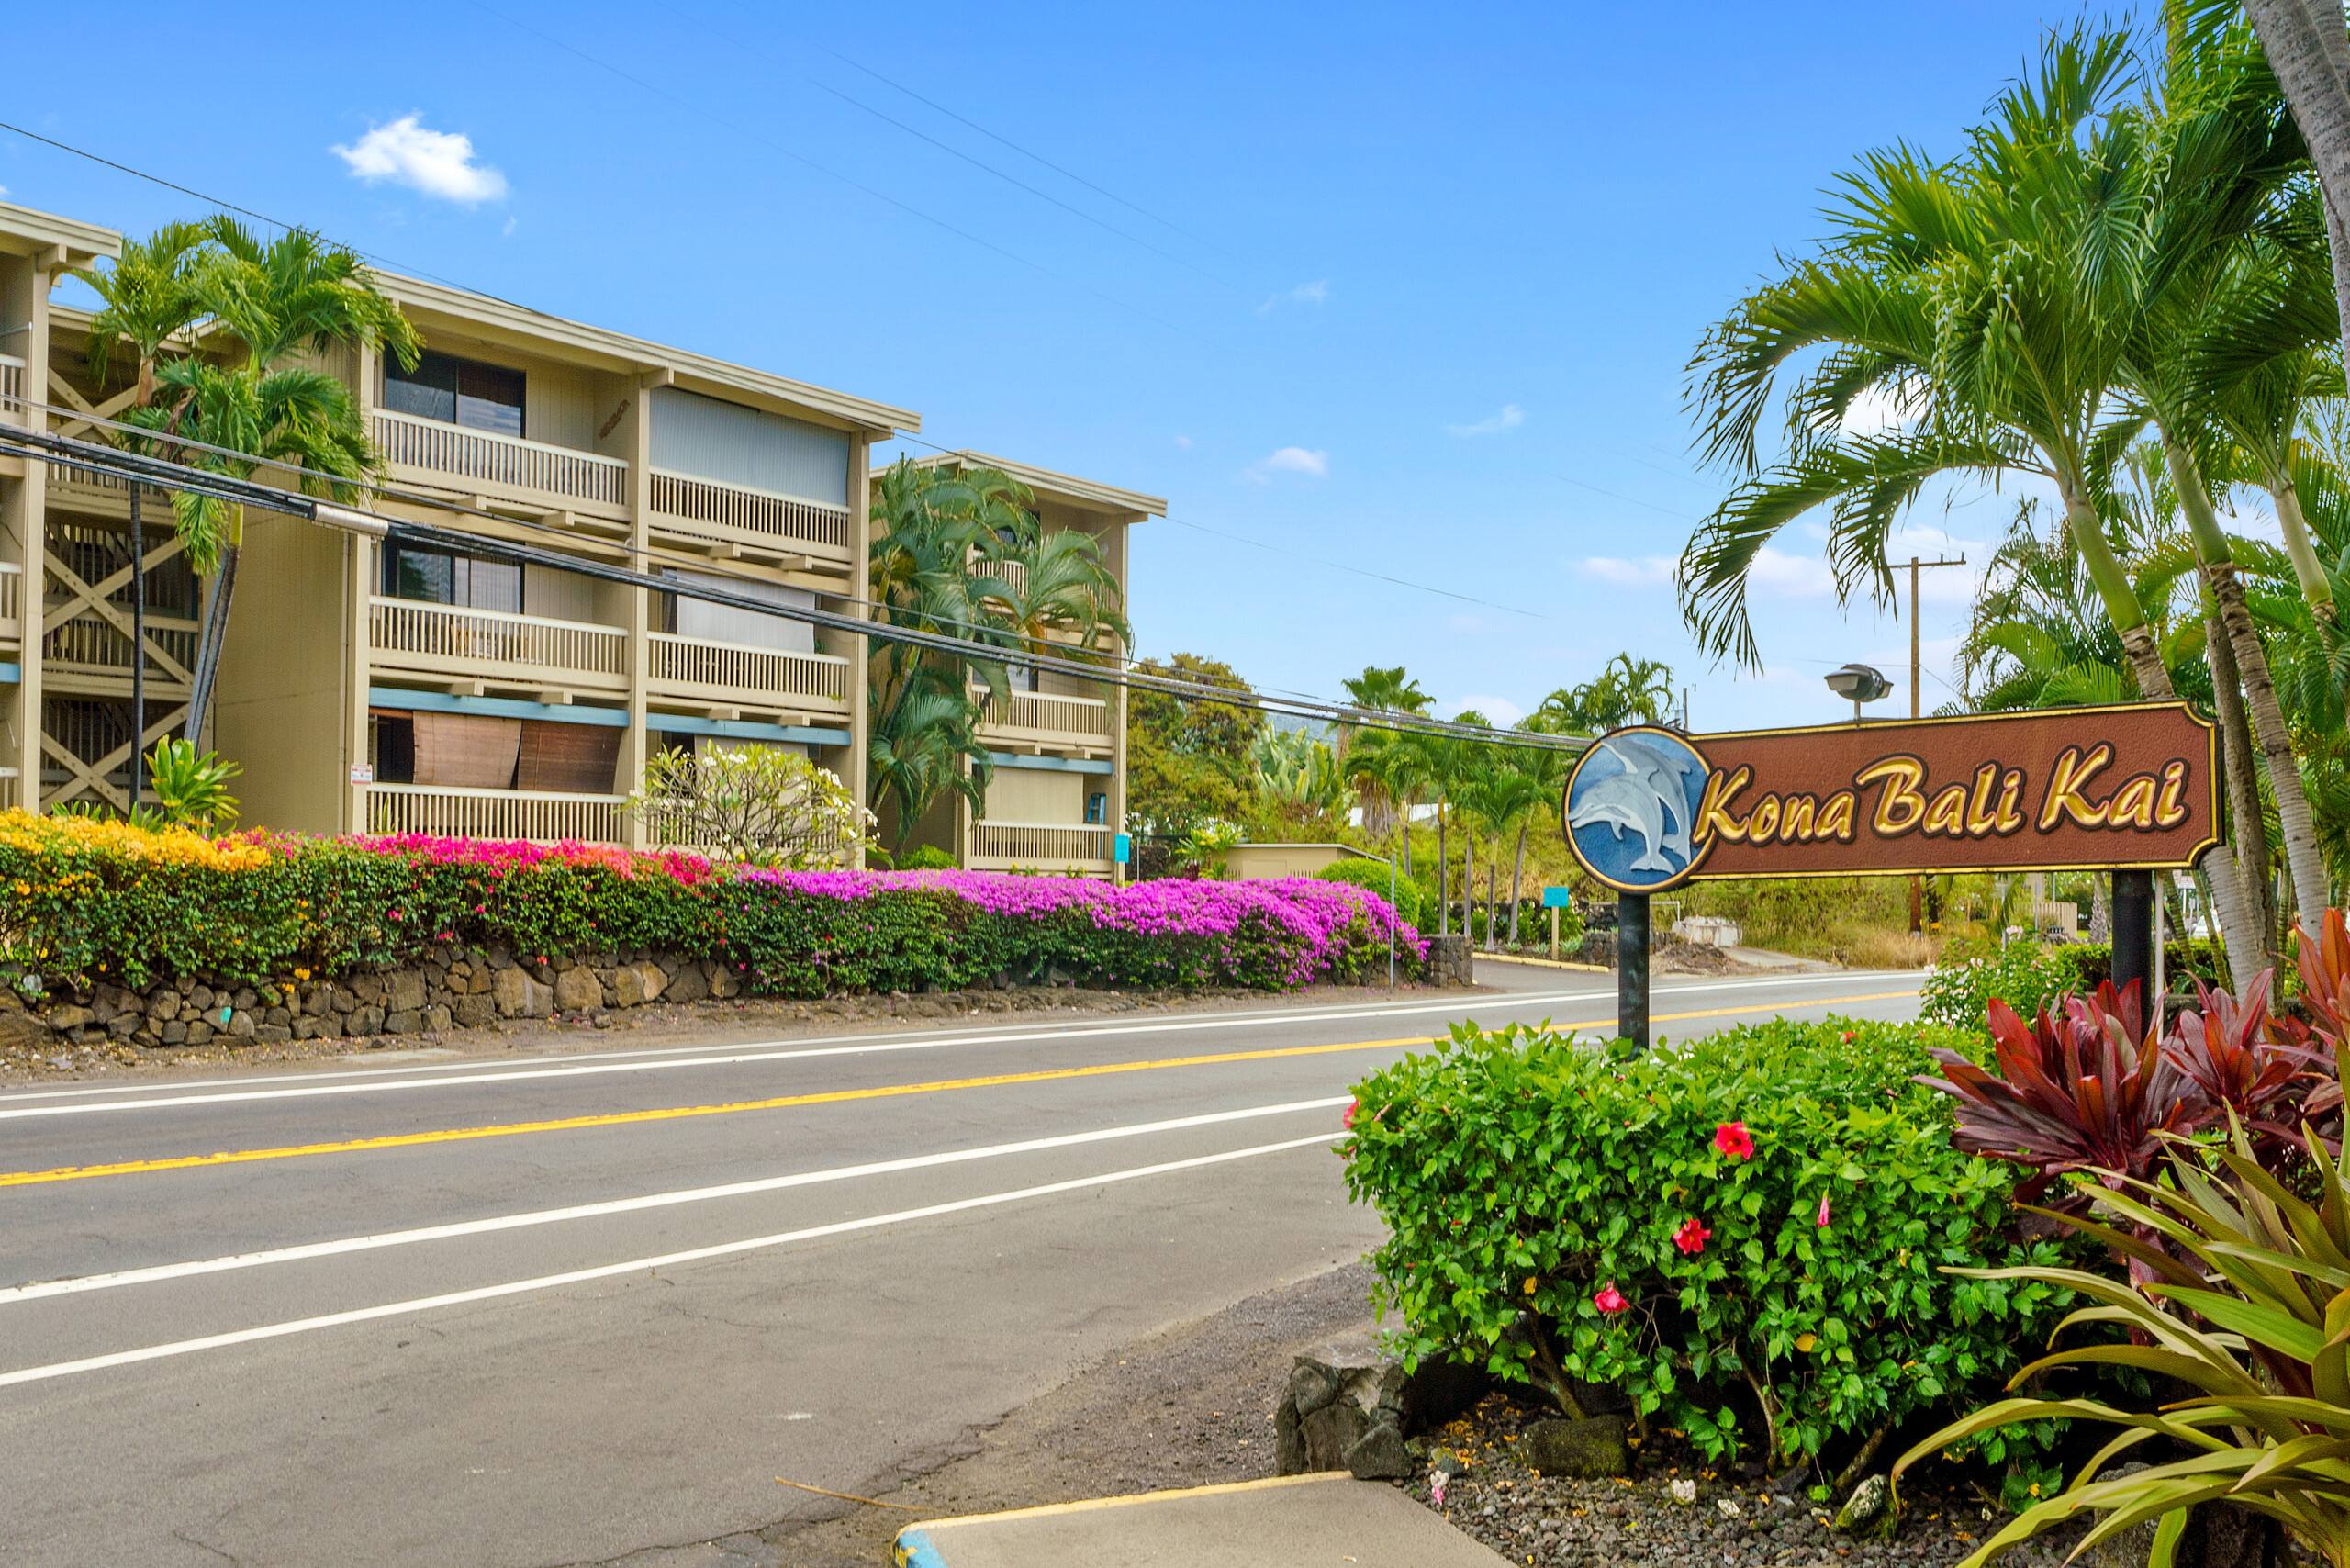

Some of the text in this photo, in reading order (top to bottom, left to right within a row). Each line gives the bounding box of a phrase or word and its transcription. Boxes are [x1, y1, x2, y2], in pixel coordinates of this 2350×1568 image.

[1693, 743, 2185, 844] Kona Bali Kai
